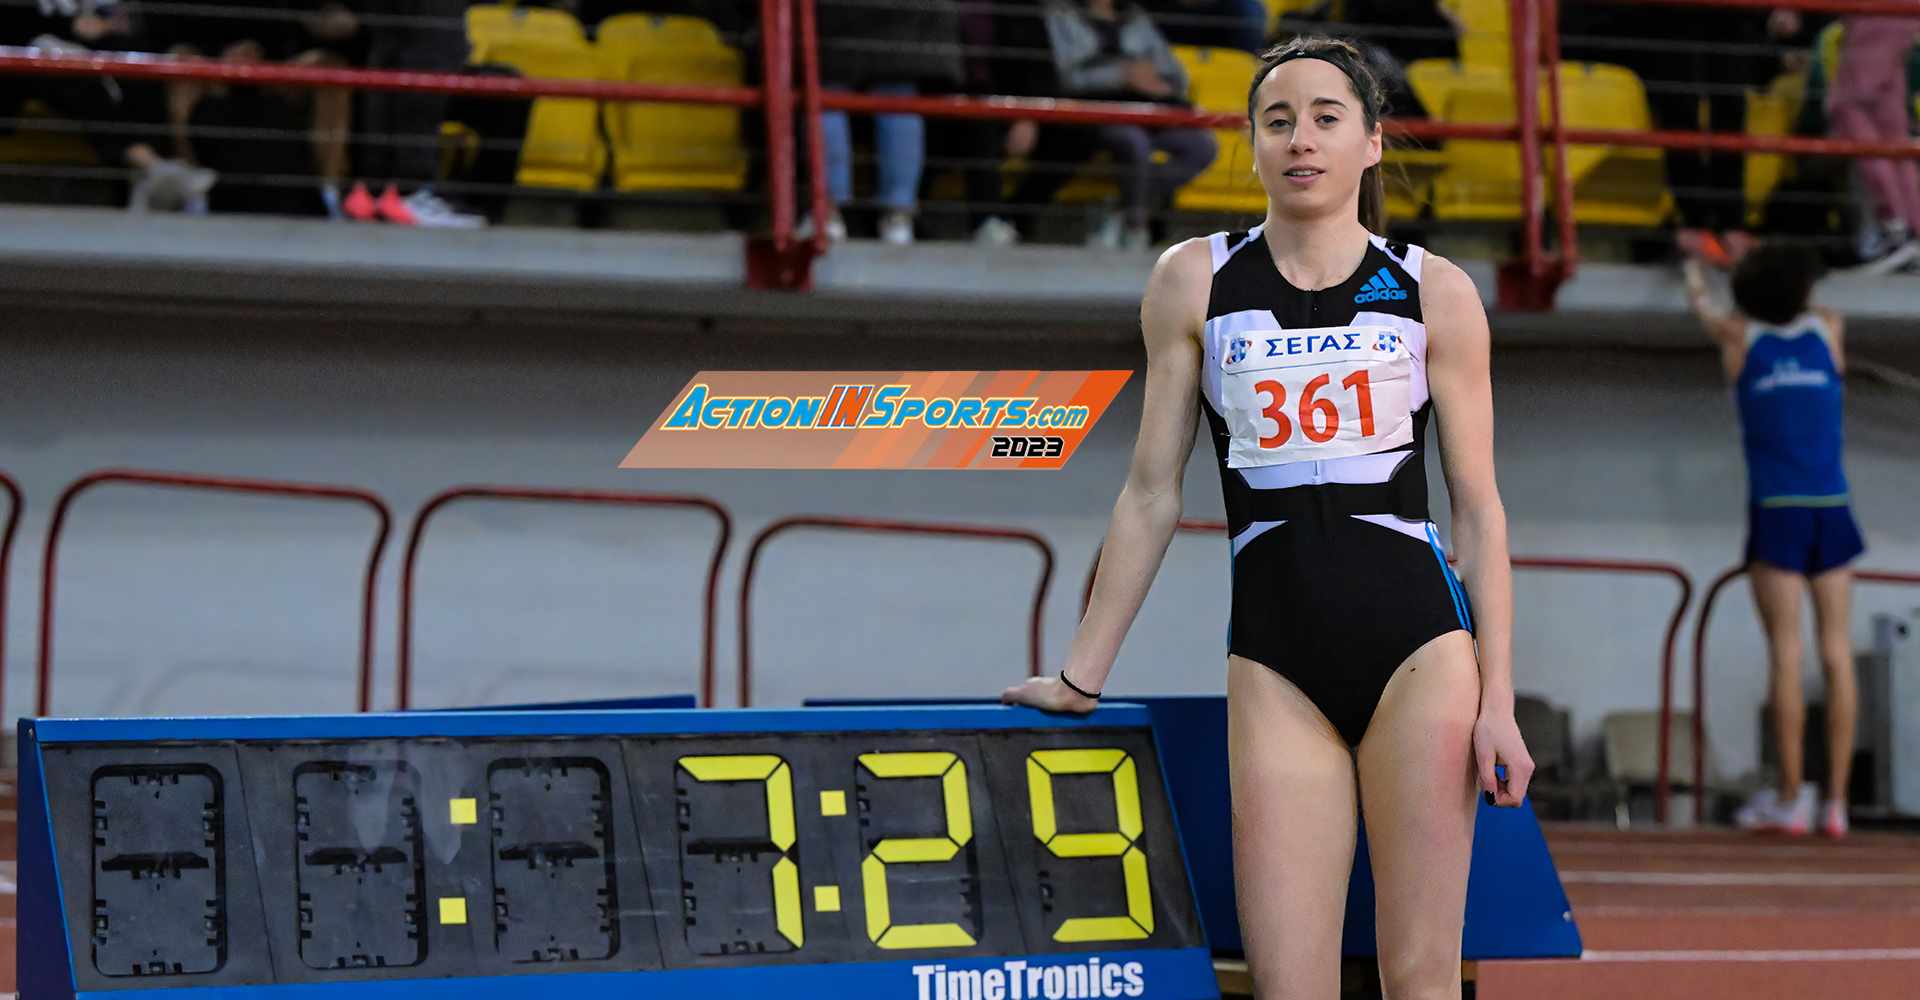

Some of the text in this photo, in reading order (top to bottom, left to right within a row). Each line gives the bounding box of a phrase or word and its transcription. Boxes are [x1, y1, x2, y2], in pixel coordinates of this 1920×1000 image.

[1354, 287, 1408, 304] adidas
[1265, 333, 1361, 358] ΣΕΓΑΣ
[1254, 369, 1376, 449] 361
[912, 957, 1144, 1000] TimeTronics
